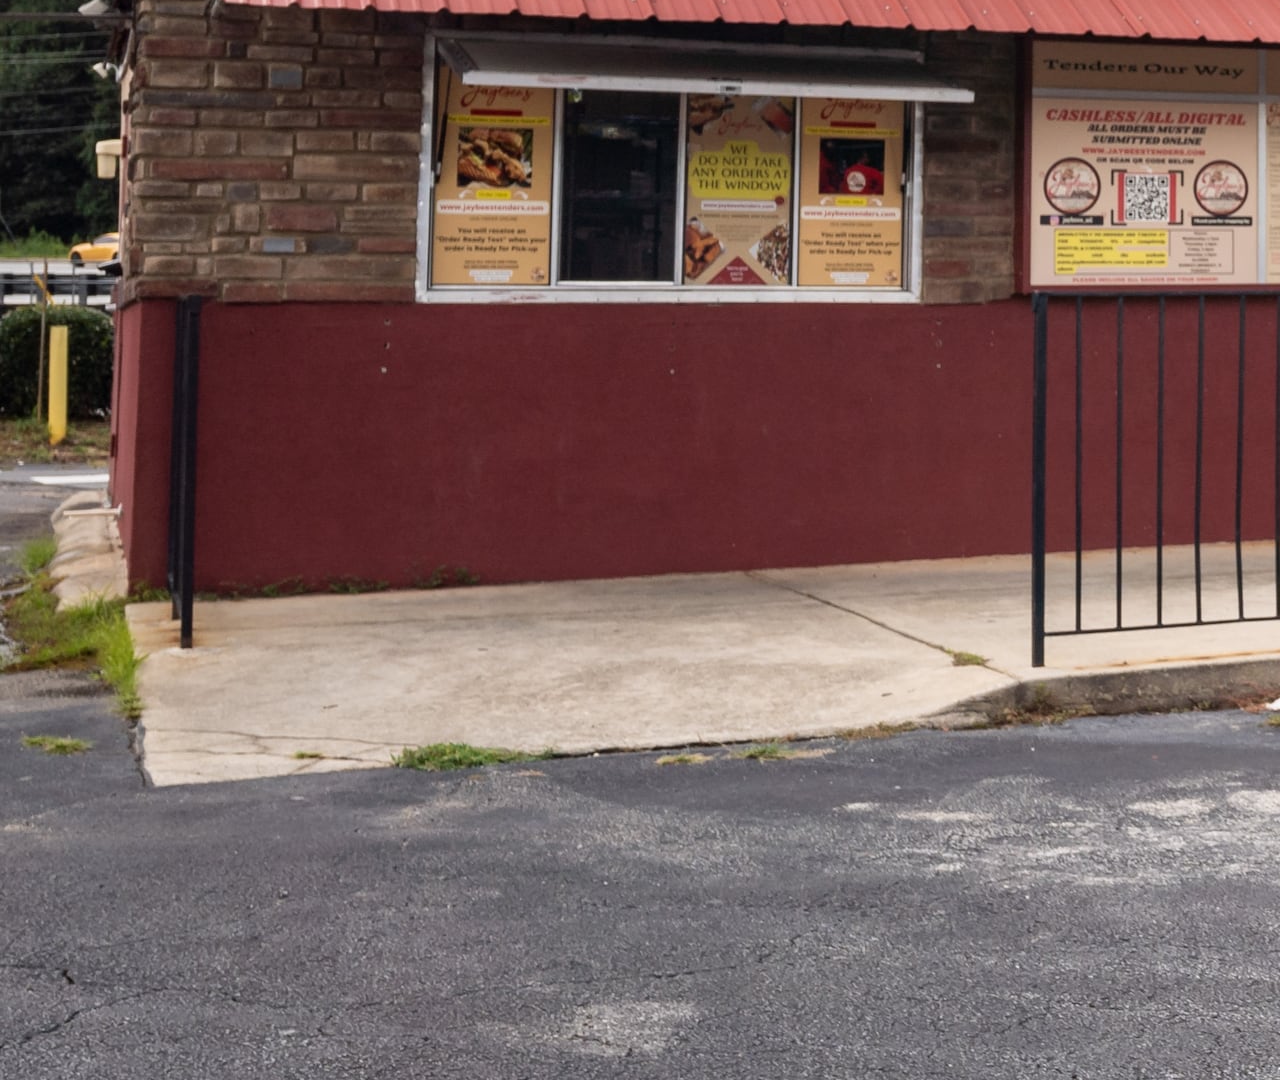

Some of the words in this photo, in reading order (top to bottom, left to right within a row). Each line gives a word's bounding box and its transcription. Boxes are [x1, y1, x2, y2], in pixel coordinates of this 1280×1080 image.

[1043, 58, 1139, 73] Tenders
[1143, 62, 1185, 75] Our
[1194, 65, 1245, 79] Way
[1046, 108, 1176, 125] CASHLESS/ALL
[1177, 111, 1247, 126] DIGITAL
[1087, 123, 1108, 133] ALL
[1110, 124, 1155, 134] ORDERS
[1157, 125, 1190, 135] MUST
[1191, 126, 1207, 135] BE
[1092, 135, 1160, 145] SUBMITTED
[1161, 136, 1202, 146] ONLINE
[730, 144, 748, 155] WE
[698, 155, 719, 166] DO
[722, 156, 748, 167] NOT
[752, 157, 783, 168] TAKE
[692, 167, 717, 177] ANY
[721, 168, 770, 179] ORDERS
[774, 169, 788, 179] AT
[699, 179, 719, 190] THE
[724, 180, 783, 191] WINDOW
